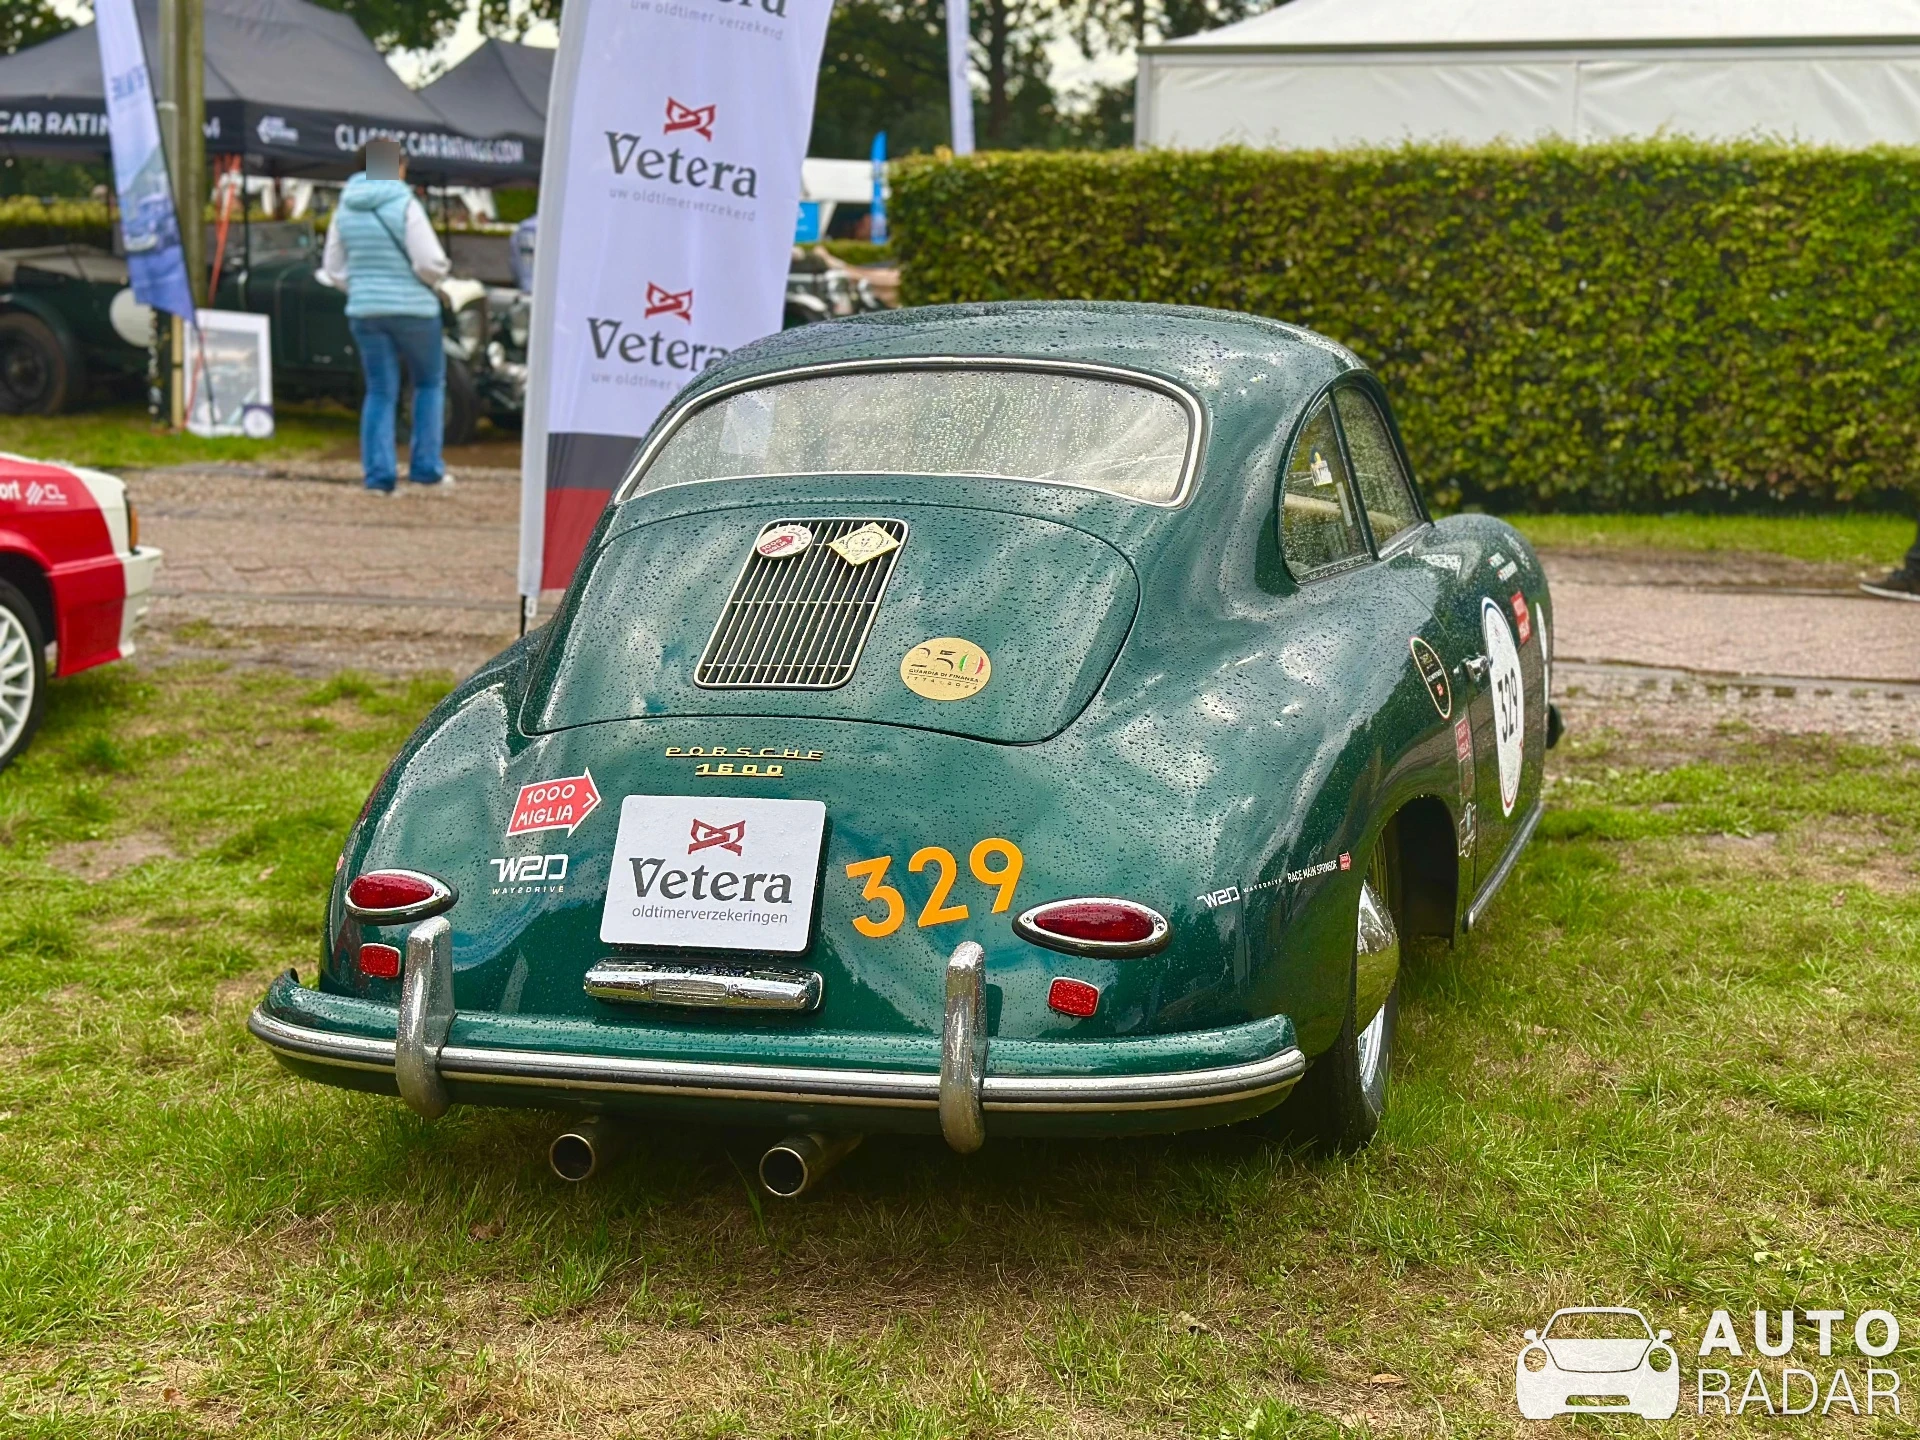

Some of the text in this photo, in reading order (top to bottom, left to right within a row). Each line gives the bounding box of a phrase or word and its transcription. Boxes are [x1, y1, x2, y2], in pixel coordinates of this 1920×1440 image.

[655, 3, 715, 24] oldtimer
[718, 14, 784, 42] verzekerd
[604, 130, 758, 199] Vetera
[609, 188, 628, 199] uw
[633, 190, 691, 210] oldtimer
[591, 372, 611, 384] uw
[615, 373, 671, 390] oldtimer
[910, 646, 985, 675] 250
[908, 668, 939, 677] GUARDIA
[948, 673, 979, 683] FINANZA
[1497, 666, 1519, 743] 329
[665, 747, 824, 761] PORSCHE
[695, 763, 784, 777] 1600
[526, 783, 577, 806] 1000
[515, 804, 574, 828] MIGLIA
[628, 857, 793, 905] Vetera
[1287, 868, 1304, 883] RACE
[492, 885, 565, 895] WAY2DRIVE
[845, 837, 1025, 939] 329
[631, 904, 789, 925] oldtimerverzekeringen
